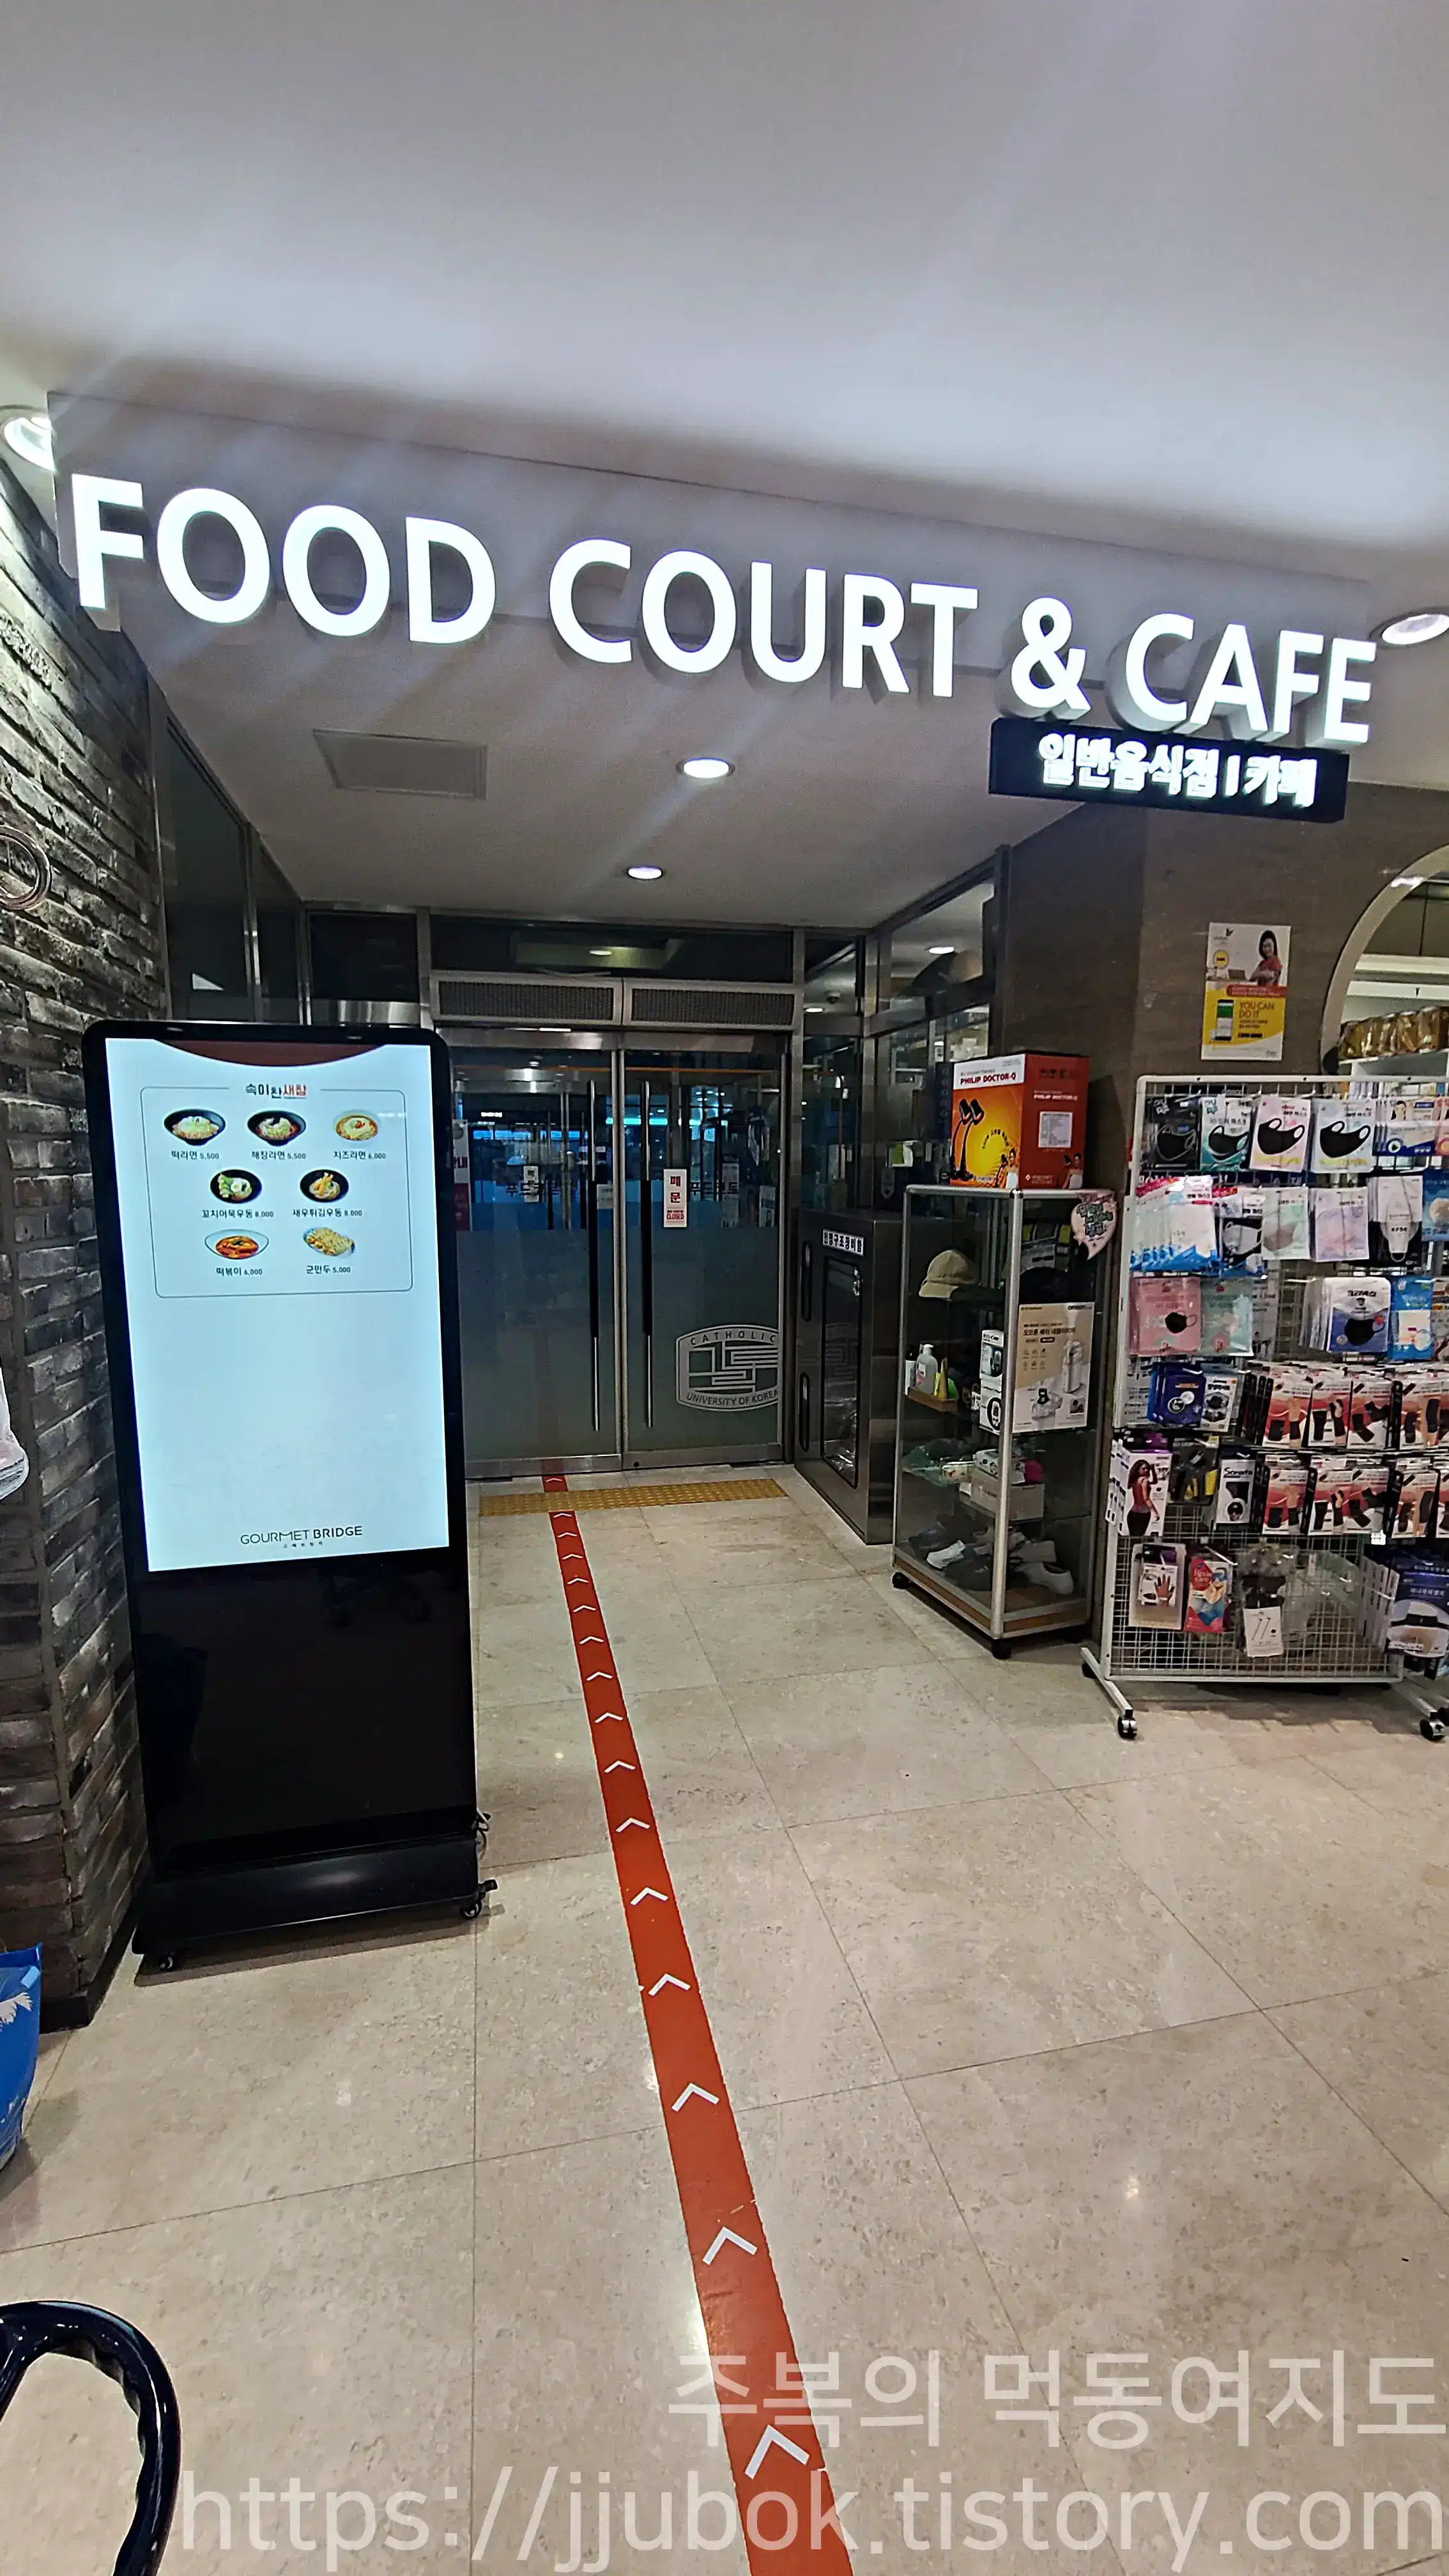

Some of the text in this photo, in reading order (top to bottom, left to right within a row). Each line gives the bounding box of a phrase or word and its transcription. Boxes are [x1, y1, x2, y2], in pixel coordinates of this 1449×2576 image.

[72, 473, 1377, 744] FOOD COURT & CAFE
[1038, 733, 1220, 798] 일반음식점
[1243, 755, 1318, 808] 카페
[1240, 1001, 1275, 1010] YOU CAN
[960, 1076, 981, 1085] PHILIP
[983, 1072, 1016, 1083] DOCTOR-Q
[252, 1150, 285, 1160] 해장라면
[334, 1150, 366, 1160] 치즈라면
[293, 1208, 342, 1217] 새우튀김우동
[306, 1265, 331, 1274] 군만두
[691, 1330, 777, 1346] CATHOLIC
[687, 1392, 738, 1406] UNIVERSITY
[739, 1396, 750, 1405] OF
[240, 1529, 310, 1544] GOURMET
[313, 1526, 362, 1539] BRIDGE
